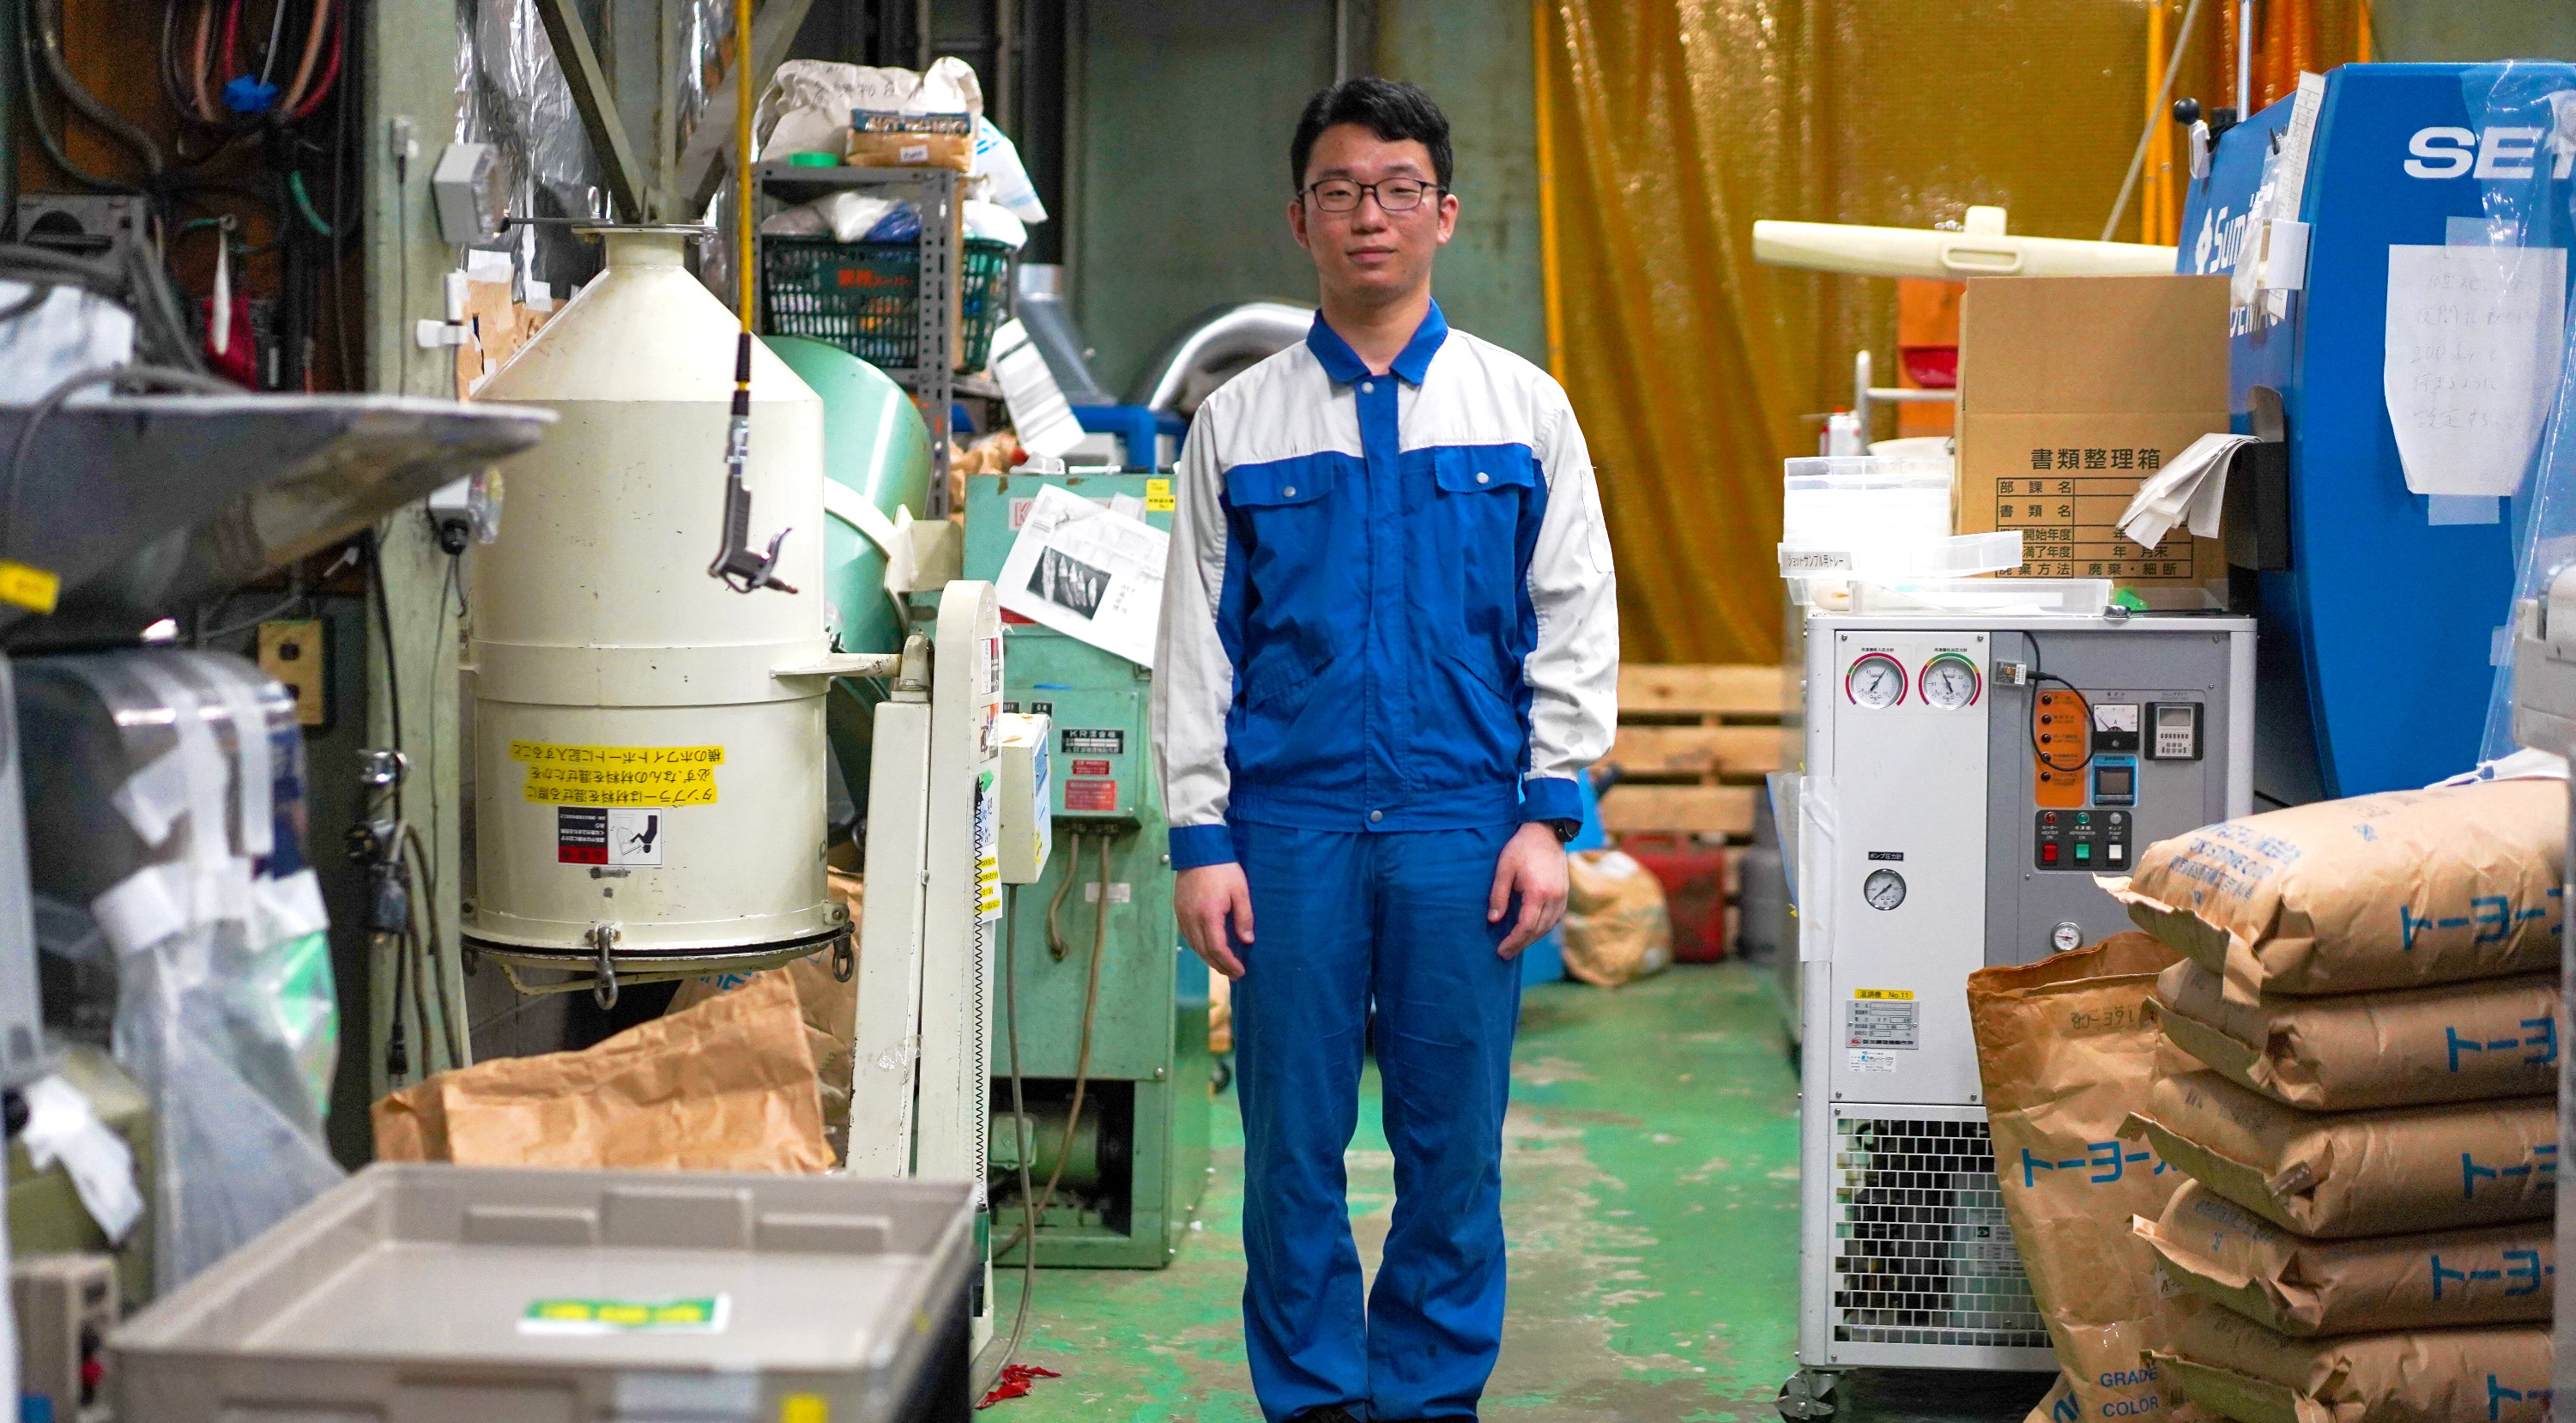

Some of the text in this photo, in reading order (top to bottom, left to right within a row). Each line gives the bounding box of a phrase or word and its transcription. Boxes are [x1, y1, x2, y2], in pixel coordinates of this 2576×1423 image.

[2030, 448, 2161, 470] 書類整理箱
[2000, 481, 2071, 494] 部課名
[2000, 504, 2071, 518] 書類名
[2000, 528, 2071, 541] 開始年度
[2022, 1141, 2178, 1188] トーヨー
[2100, 1366, 2158, 1388] GRADE
[2103, 1396, 2159, 1417] COLOR
